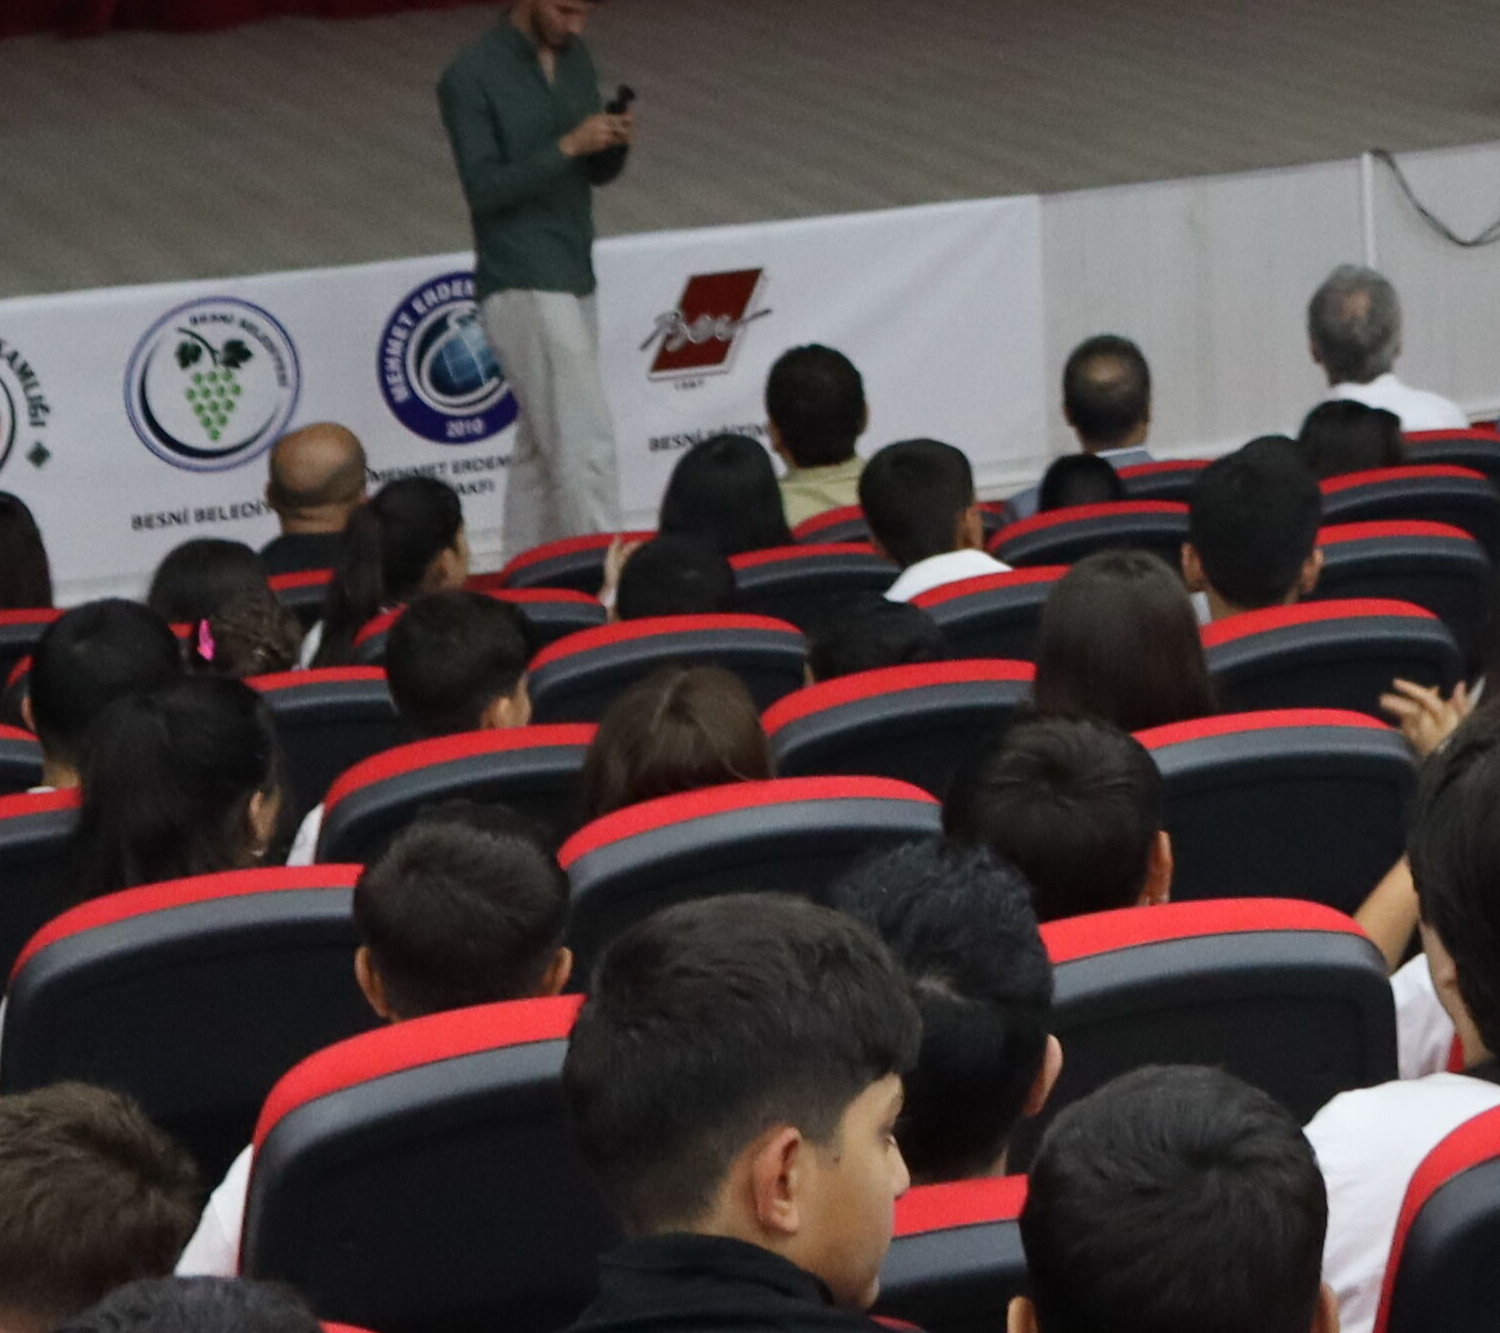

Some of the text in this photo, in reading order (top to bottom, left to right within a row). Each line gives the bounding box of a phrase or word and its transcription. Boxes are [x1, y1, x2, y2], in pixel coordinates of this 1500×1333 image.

[445, 417, 486, 438] 2010
[456, 478, 496, 496] AKFI
[131, 506, 190, 531] BESNİ
